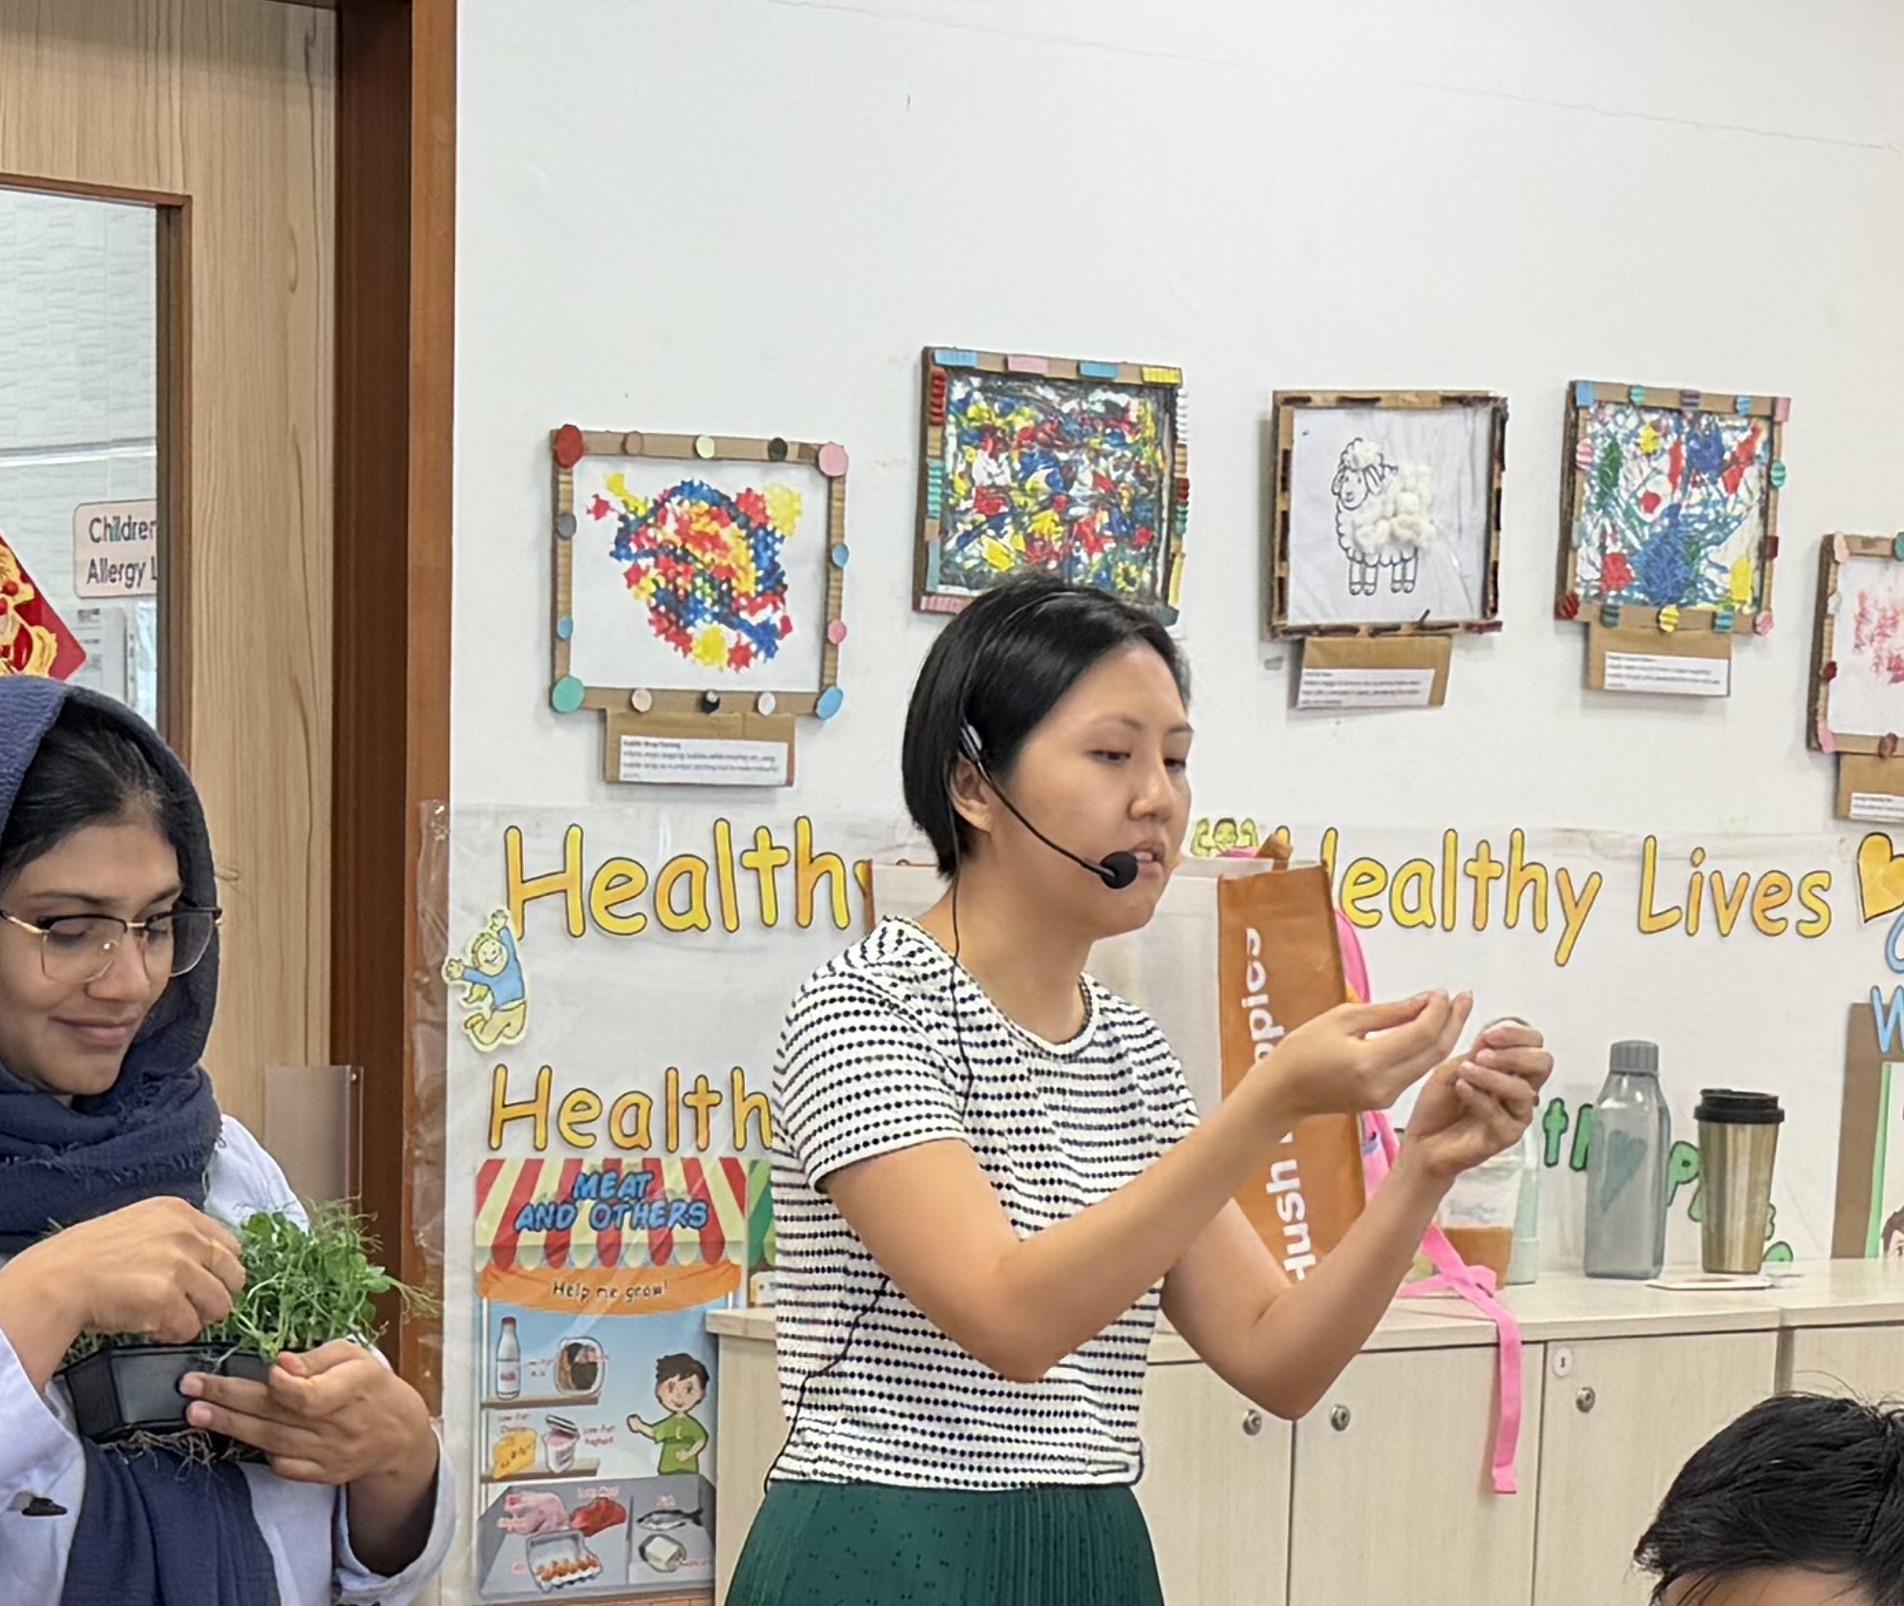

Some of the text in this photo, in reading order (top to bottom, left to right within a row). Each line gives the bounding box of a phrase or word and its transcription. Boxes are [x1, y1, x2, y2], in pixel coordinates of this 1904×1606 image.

[86, 557, 147, 589] Allergy
[504, 815, 871, 940] Health
[1636, 833, 1834, 939] Lives
[572, 1170, 655, 1202] MEAT
[514, 1198, 710, 1234] AND OTHERS
[552, 1280, 590, 1300] Help
[626, 1280, 669, 1301] grow!
